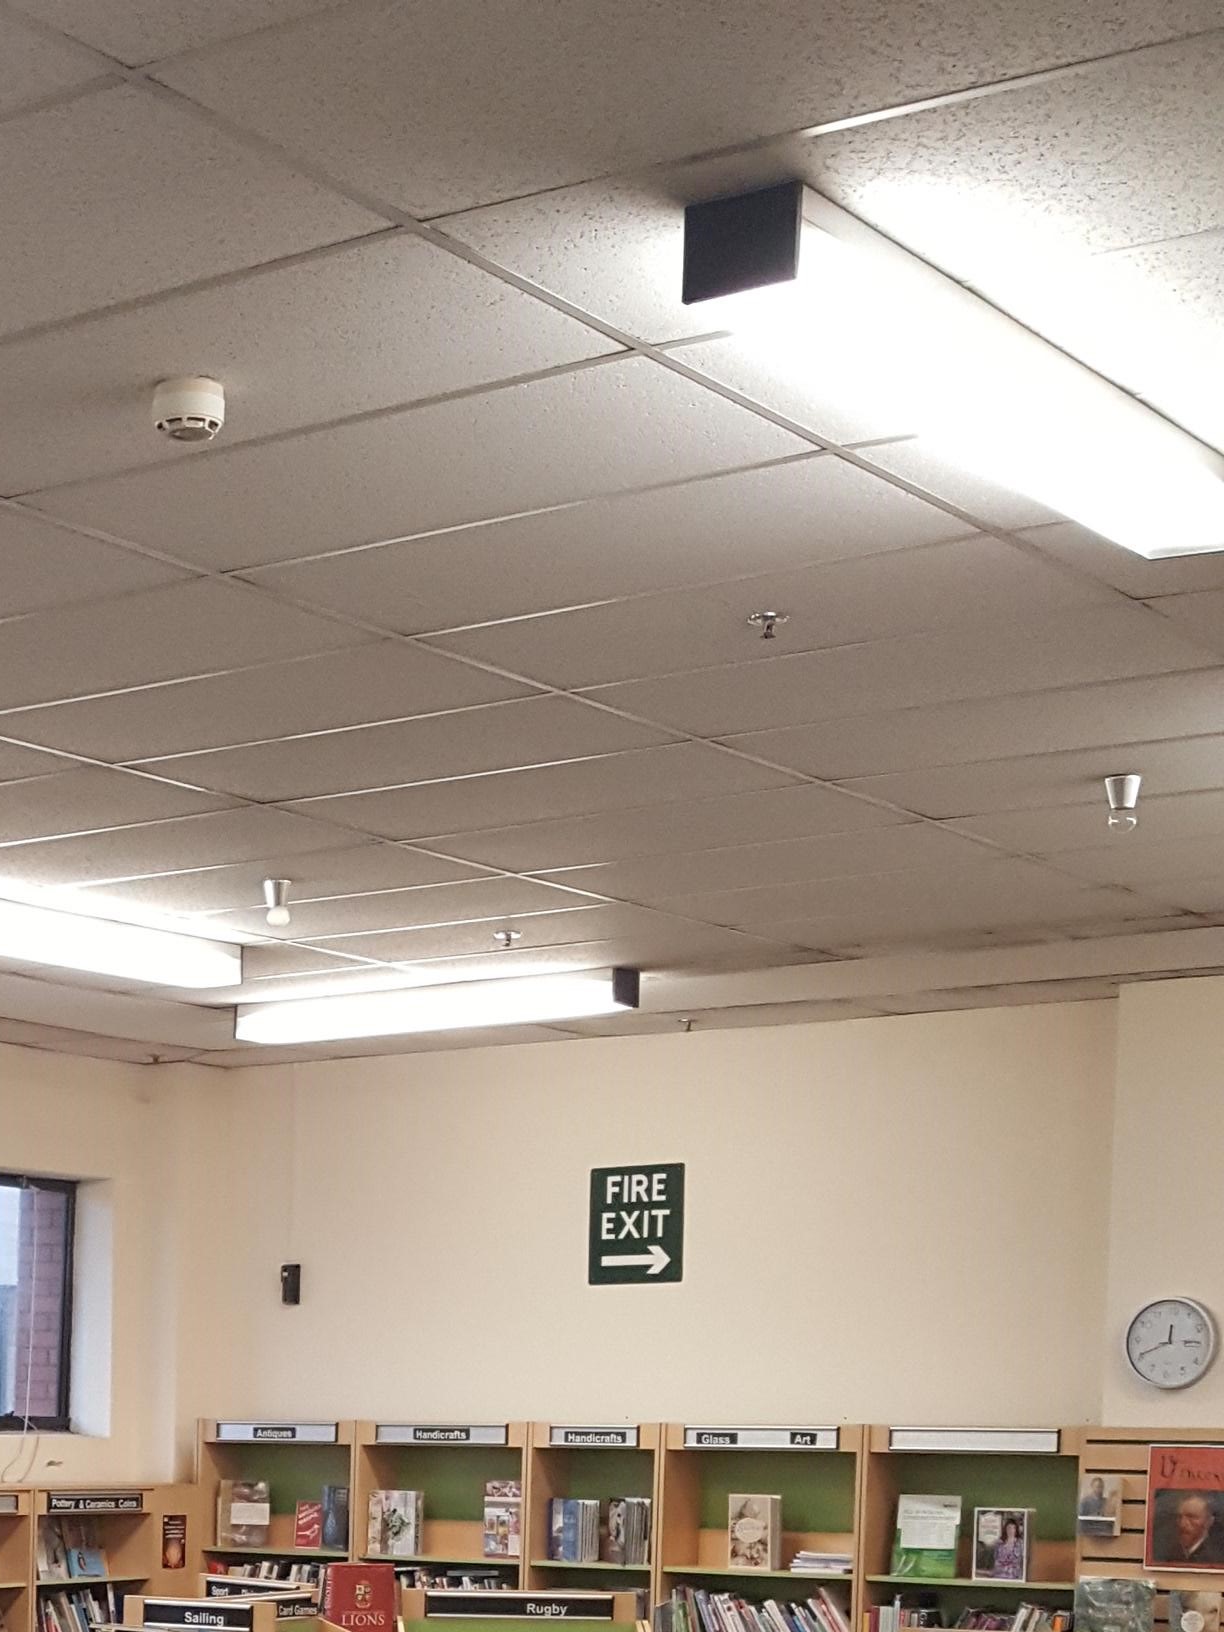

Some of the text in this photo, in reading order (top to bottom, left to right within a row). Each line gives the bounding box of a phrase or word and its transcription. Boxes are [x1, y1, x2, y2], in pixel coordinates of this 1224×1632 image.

[606, 1173, 667, 1204] FIRE
[601, 1208, 671, 1240] EXIT
[256, 1429, 292, 1438] Antiques
[416, 1429, 467, 1440] Handicrafts
[567, 1432, 622, 1444] Handicrafts
[701, 1433, 811, 1445] Glass Art
[52, 1499, 74, 1510] Pottery
[86, 1500, 115, 1509] Ceramics
[118, 1499, 137, 1508] Coins
[211, 1585, 229, 1596] Sport
[279, 1605, 317, 1615] Card Games
[527, 1603, 568, 1616] Rugby
[184, 1612, 224, 1626] Sailing
[341, 1614, 385, 1626] LIONS
